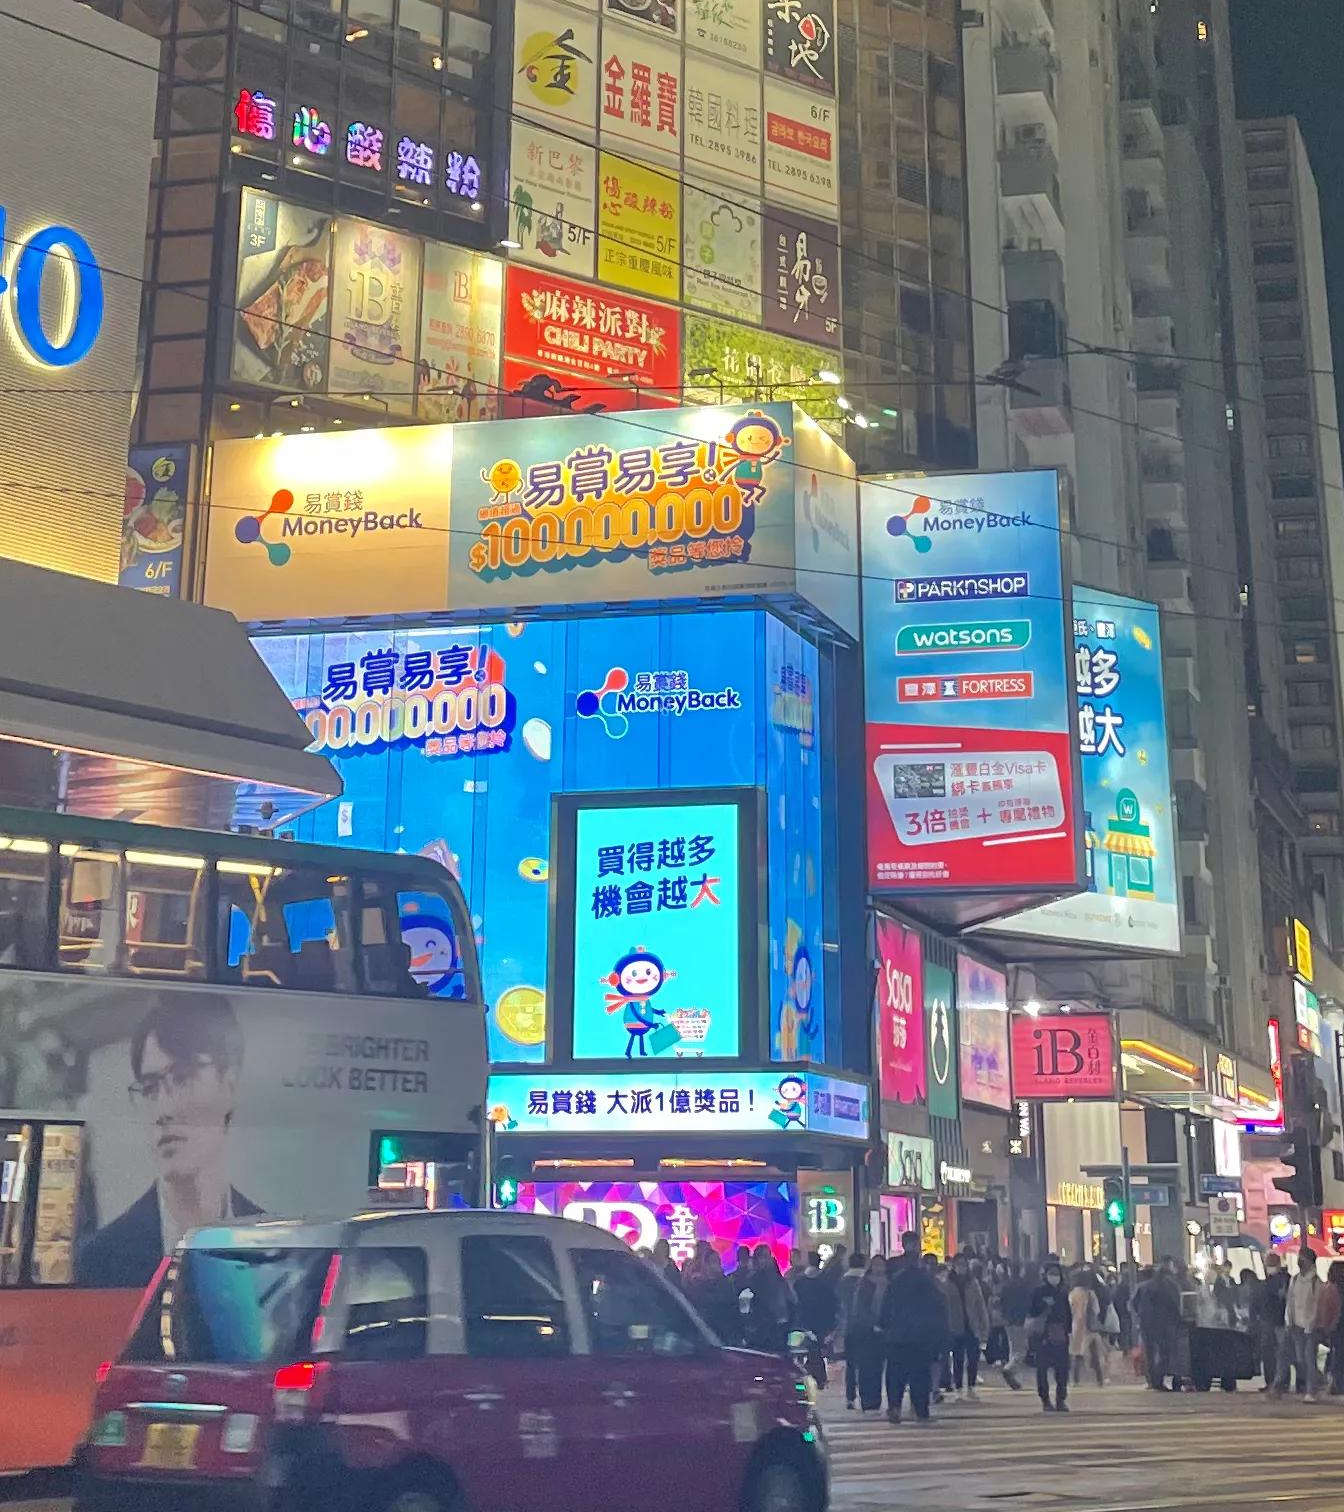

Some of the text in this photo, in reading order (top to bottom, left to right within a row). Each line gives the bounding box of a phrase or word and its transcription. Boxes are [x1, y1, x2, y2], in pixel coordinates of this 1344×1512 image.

[810, 105, 831, 123] 6/F
[567, 223, 591, 246] 5/F
[656, 234, 677, 255] 5/F
[604, 247, 674, 280] 正宗重慶風味
[544, 289, 651, 344] 麻辣派對
[592, 336, 648, 369] PARTY
[304, 489, 364, 515] 易賞錢
[281, 507, 423, 538] MoneyBack
[923, 511, 1032, 533] MoneyBack
[144, 561, 173, 580] 6/F
[913, 625, 1014, 647] watsons
[635, 672, 688, 692] 易賞錢
[962, 678, 1026, 695] FORTRESS
[617, 689, 739, 716] MoneyBack
[905, 809, 947, 836] 3倍
[596, 834, 717, 879] 買得越多
[591, 873, 722, 920] 機會越大
[348, 1068, 428, 1093] BETTER
[527, 1090, 597, 1115] 易賞錢
